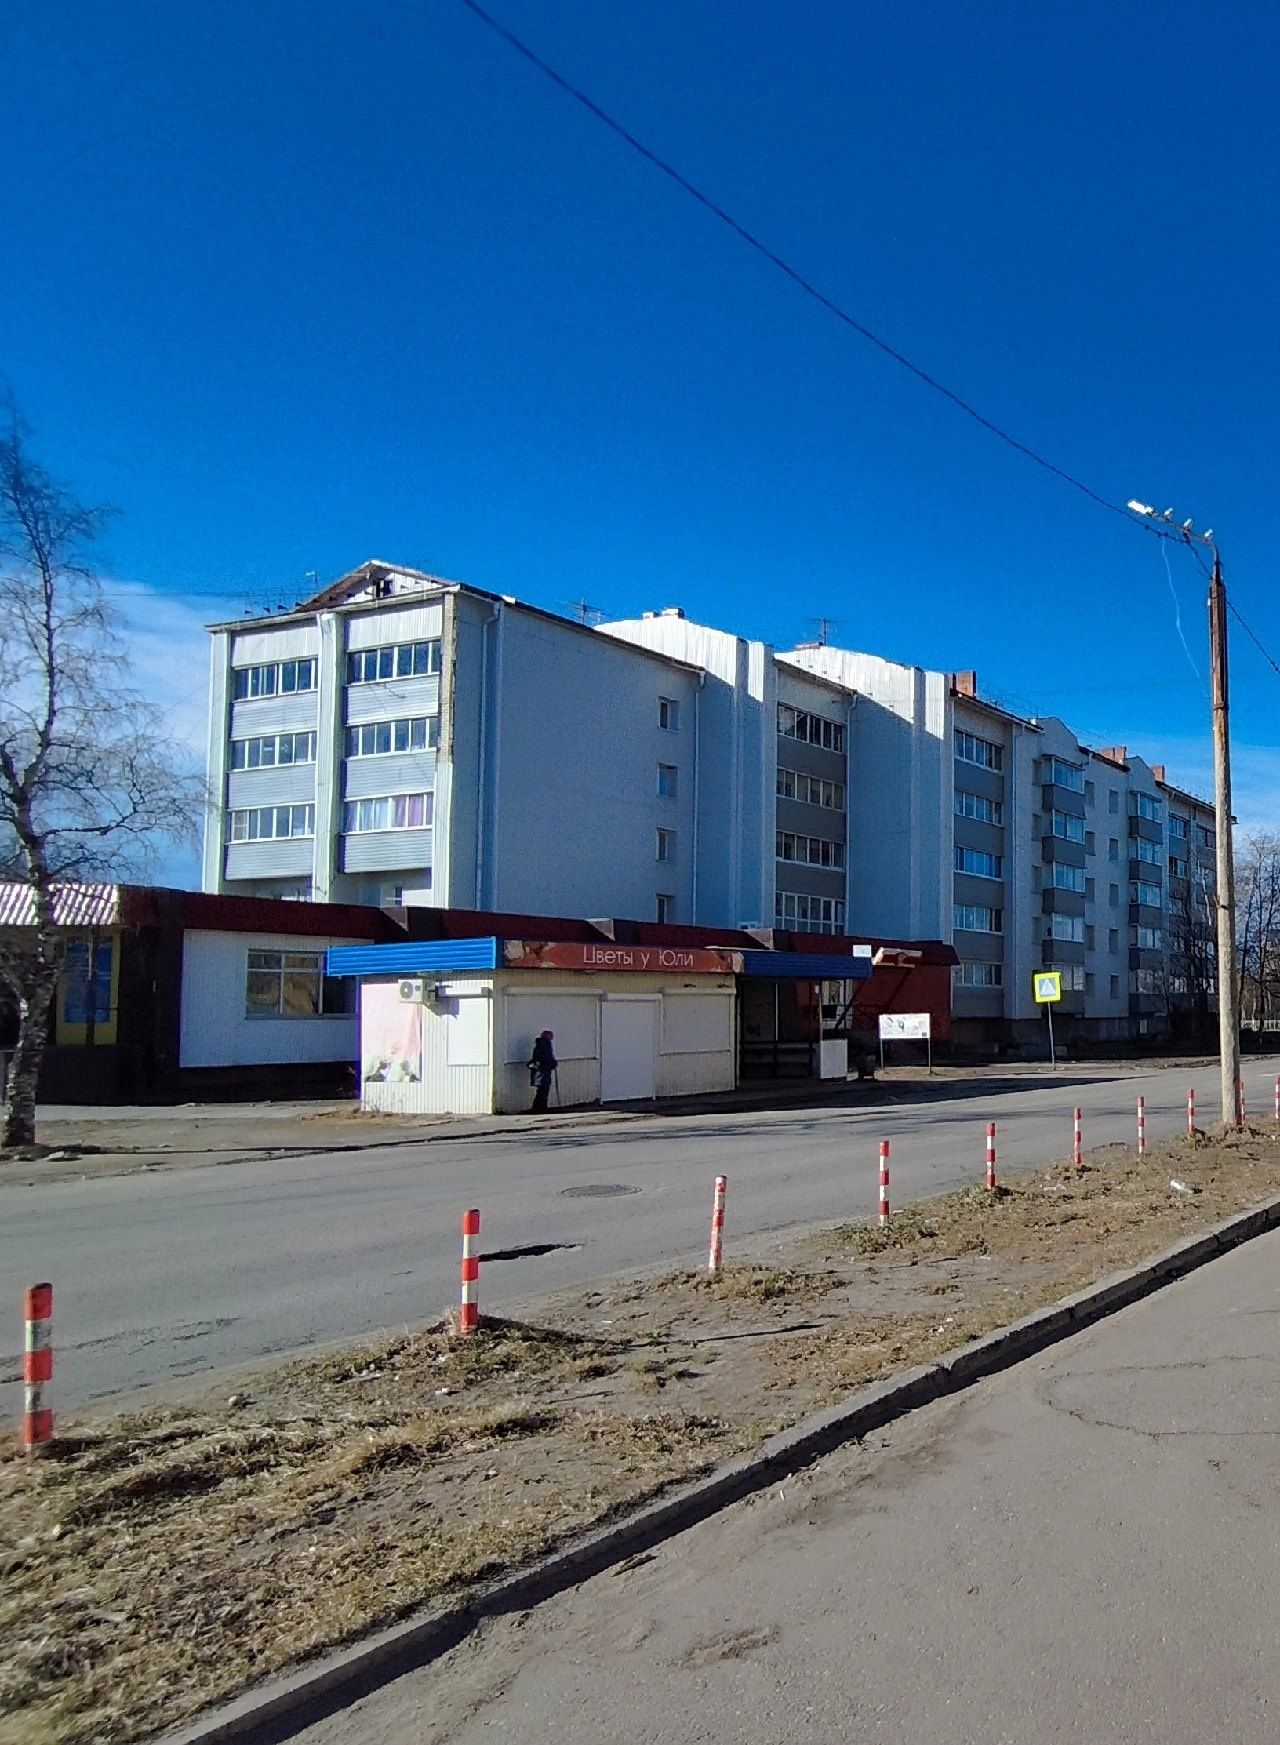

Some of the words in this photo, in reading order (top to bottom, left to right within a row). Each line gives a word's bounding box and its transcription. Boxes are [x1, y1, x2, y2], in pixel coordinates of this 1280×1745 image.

[583, 946, 633, 965] Цветы
[640, 952, 650, 969] у
[659, 949, 694, 966] Юли
